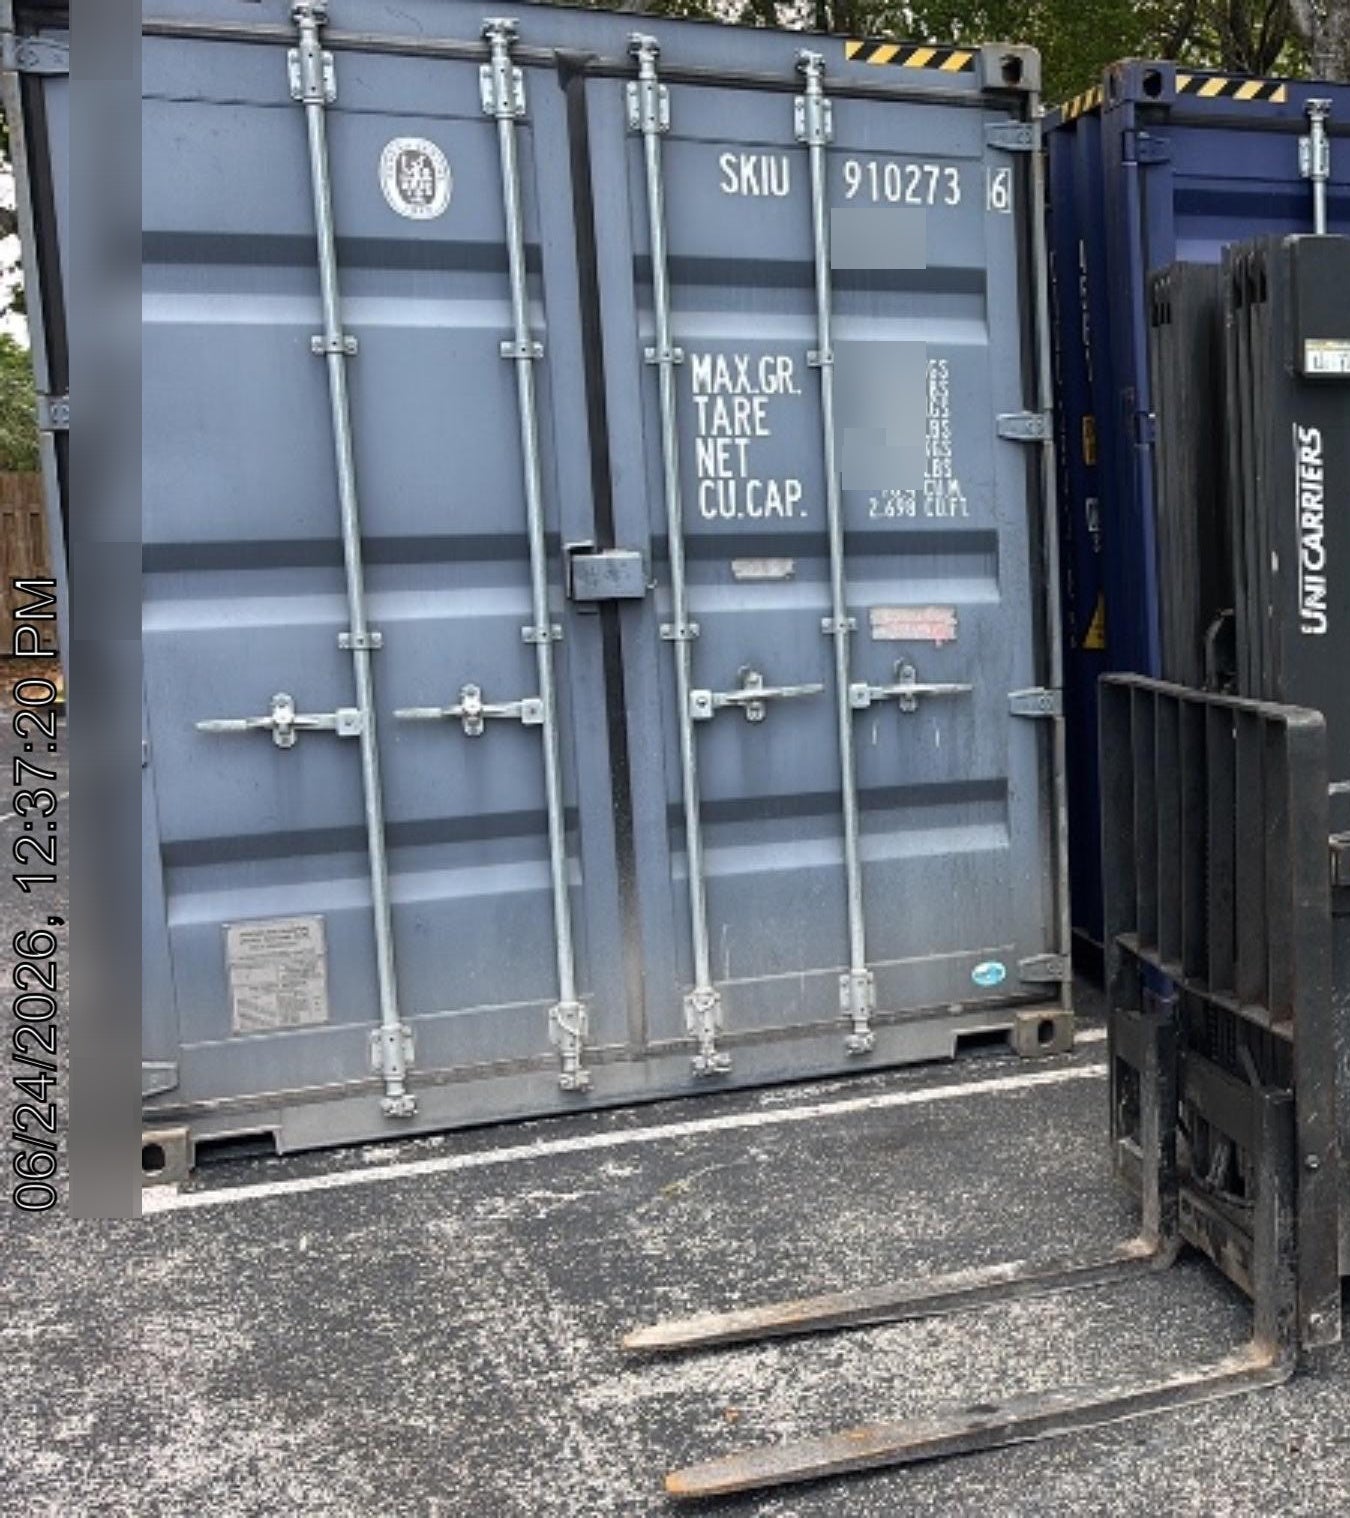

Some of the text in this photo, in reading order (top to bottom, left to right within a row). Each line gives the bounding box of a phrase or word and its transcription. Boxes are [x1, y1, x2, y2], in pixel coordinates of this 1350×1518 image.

[719, 152, 1010, 210] SKIU 910273 6
[691, 353, 802, 394] MAX.GR.
[692, 395, 771, 436] TARE
[695, 437, 751, 478] NET
[700, 479, 809, 520] CU.CAP.
[1294, 423, 1328, 635] UNICARRIERS
